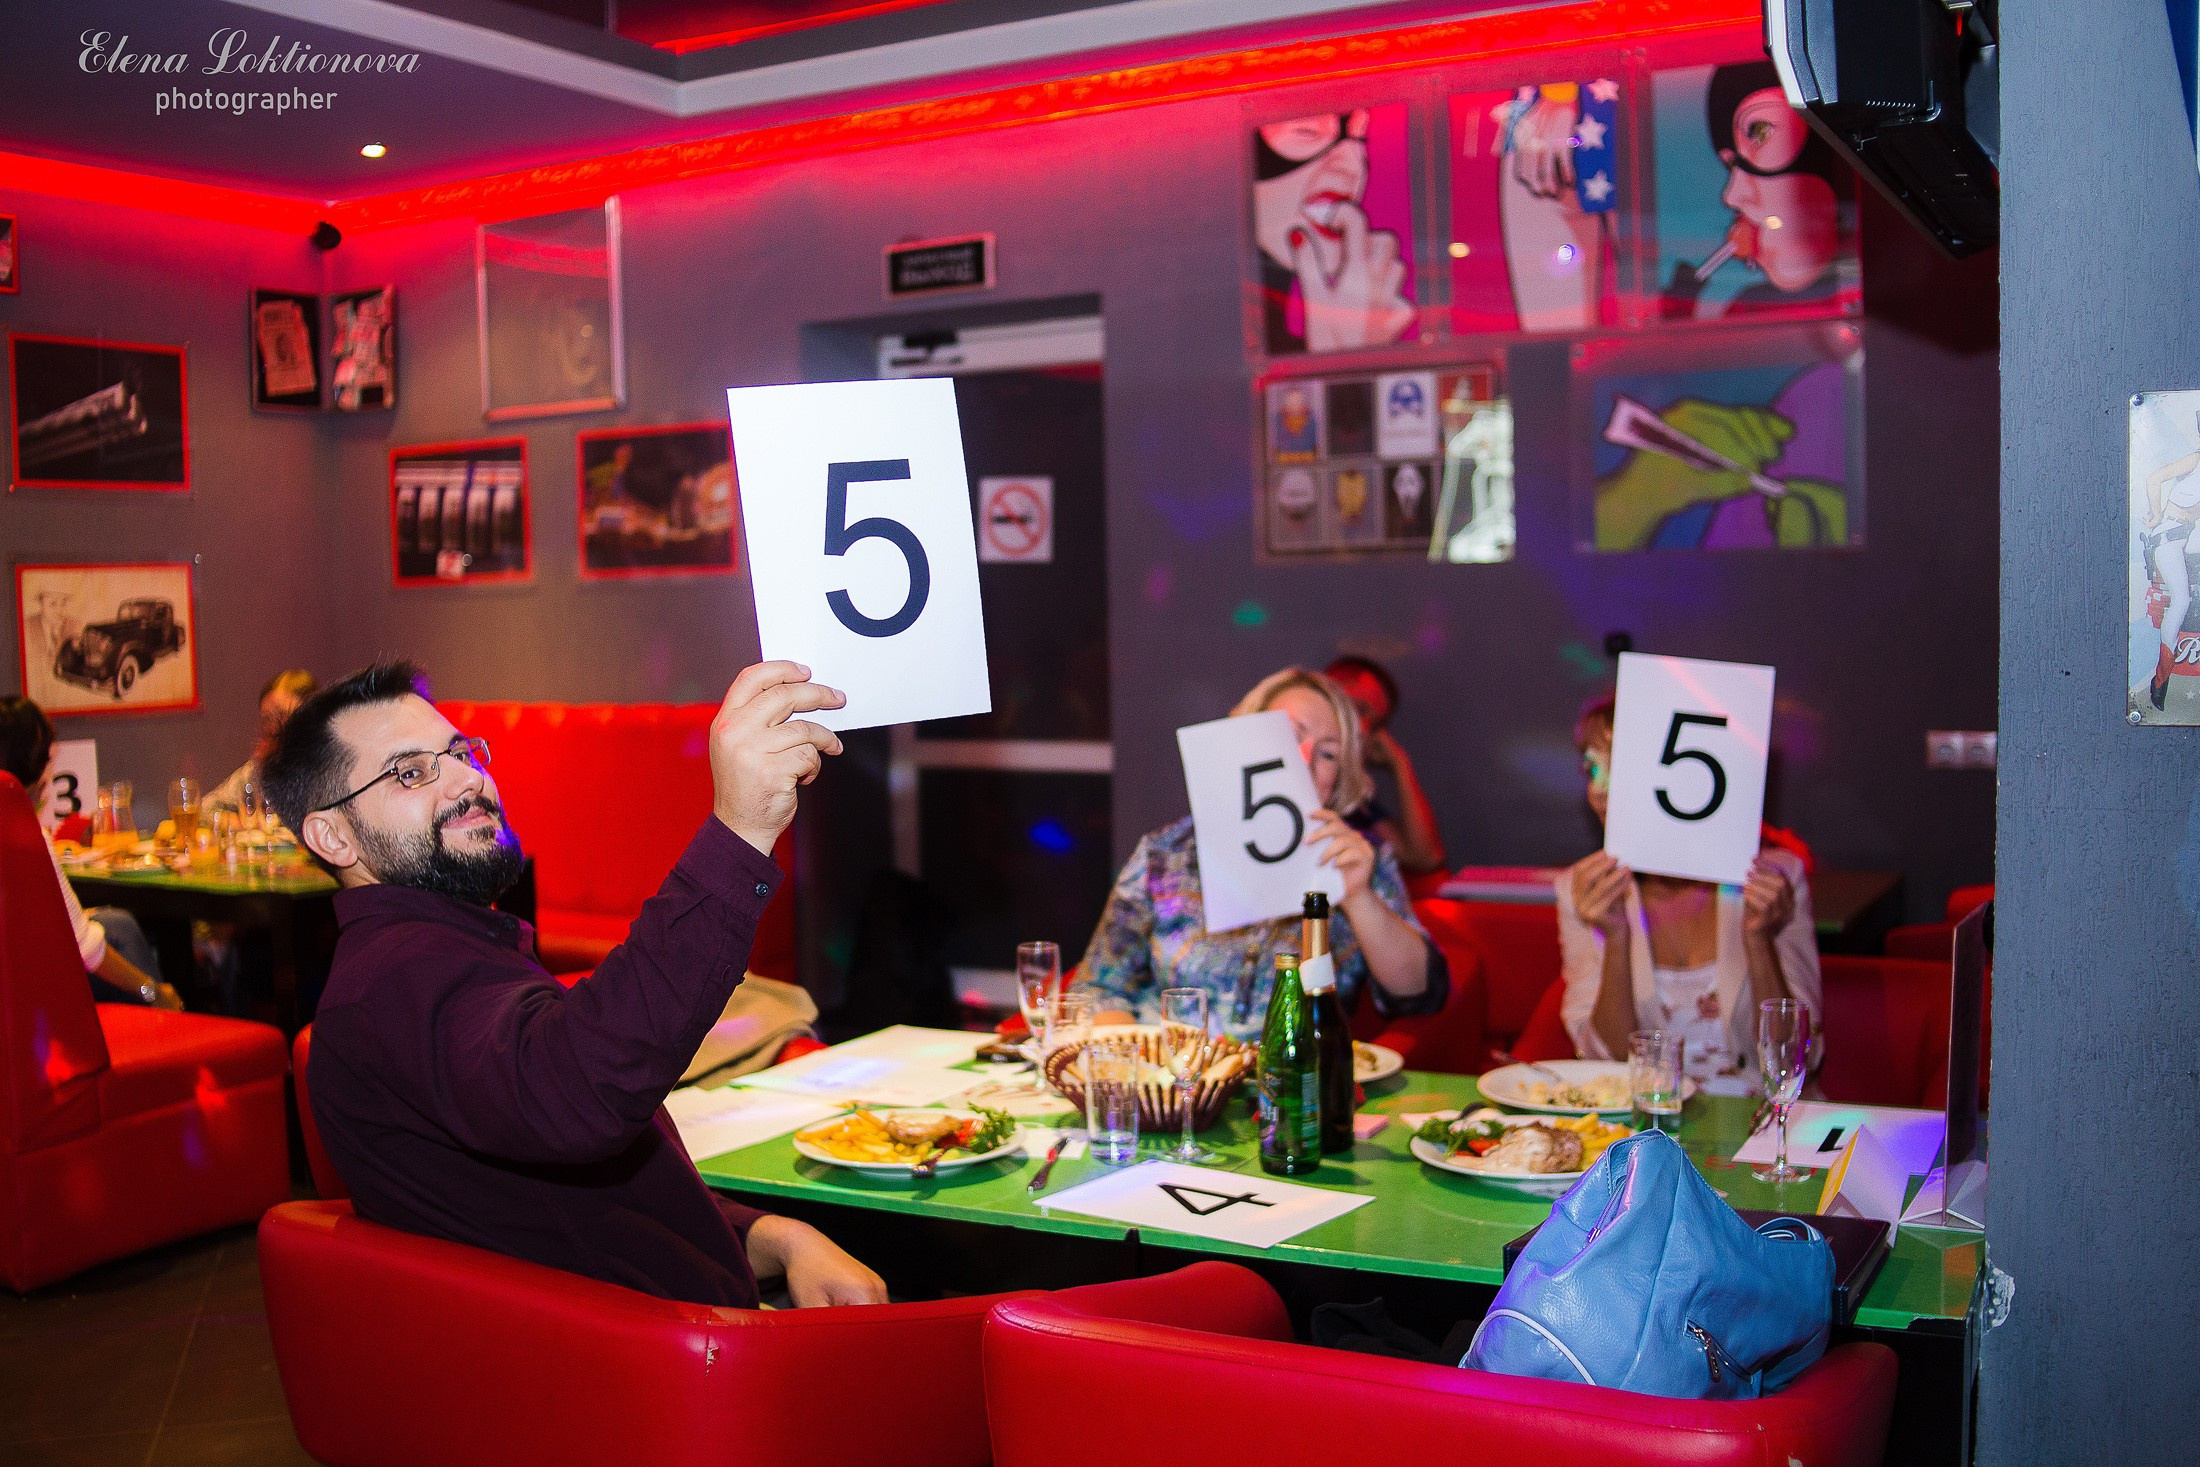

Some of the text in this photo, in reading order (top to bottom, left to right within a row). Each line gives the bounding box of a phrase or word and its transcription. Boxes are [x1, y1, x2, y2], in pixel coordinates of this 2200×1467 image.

[825, 459, 930, 638] 5
[52, 773, 82, 818] 3
[1242, 758, 1304, 864] 5
[1655, 712, 1728, 821] 5
[1158, 1184, 1276, 1215] 4
